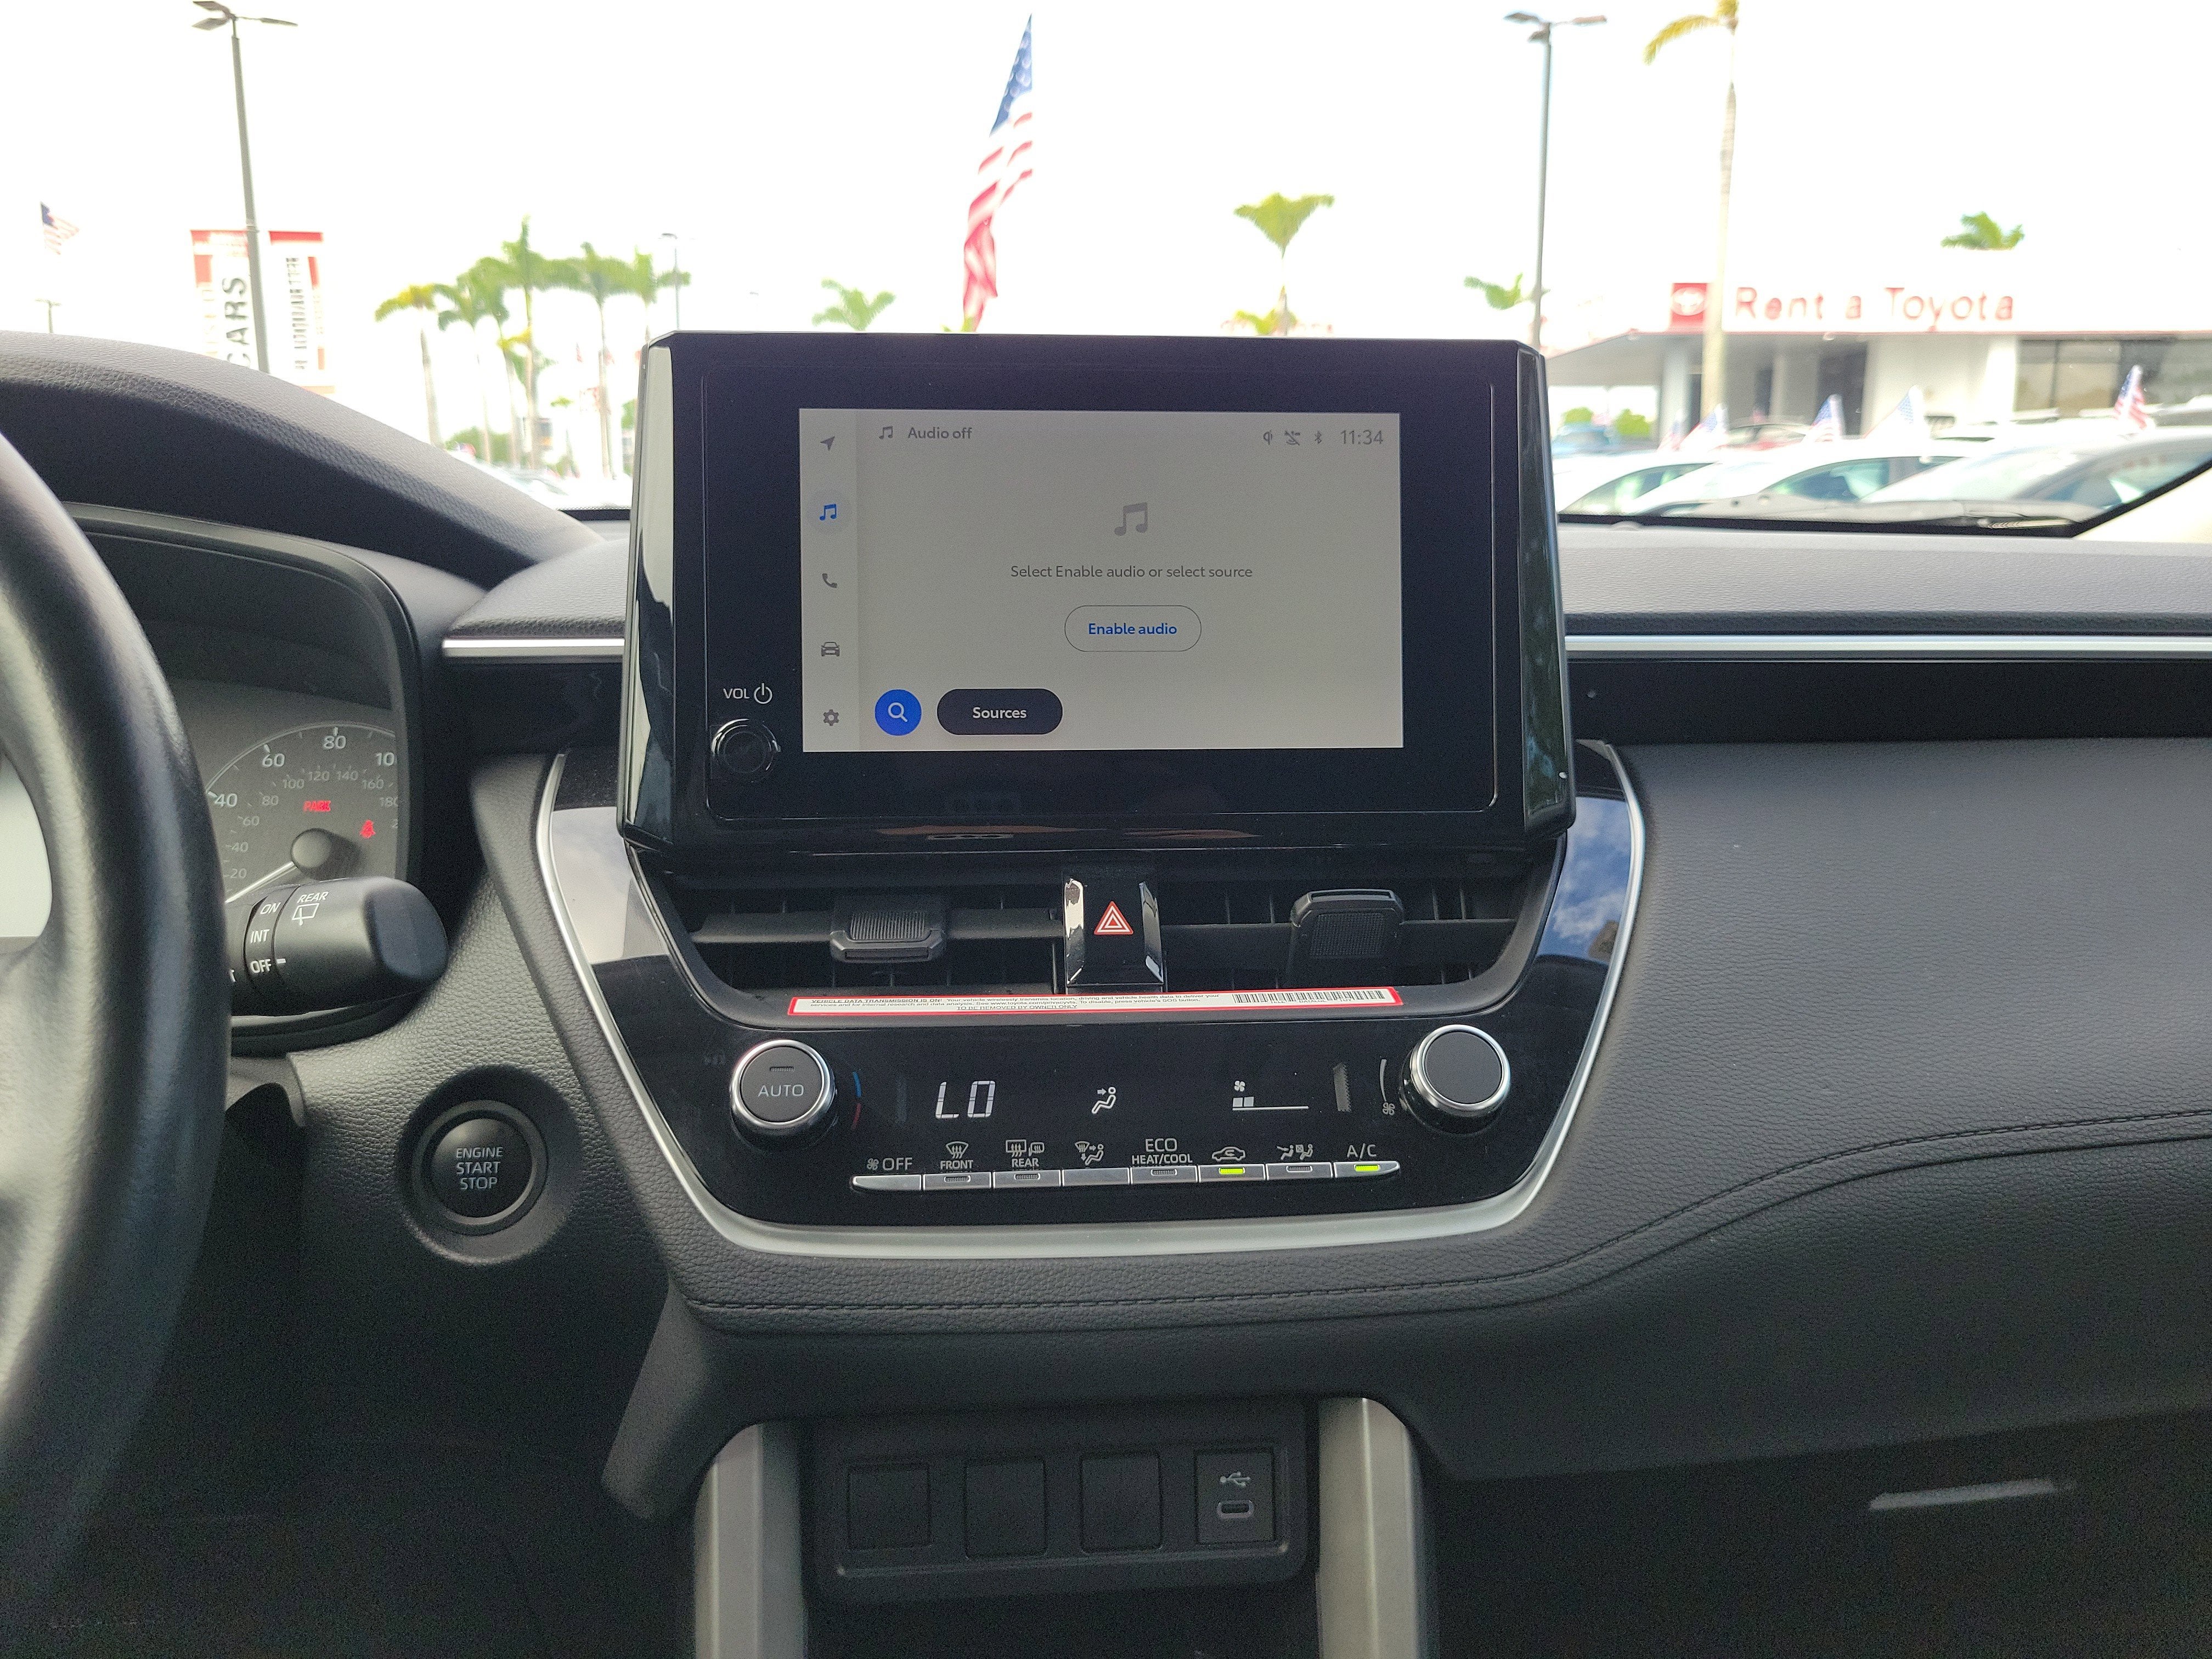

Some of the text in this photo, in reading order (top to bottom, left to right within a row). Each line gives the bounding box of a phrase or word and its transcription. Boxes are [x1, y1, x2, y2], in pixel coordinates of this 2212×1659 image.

[1735, 286, 2015, 332] Rent a Toyota
[222, 277, 251, 368] CARS
[907, 426, 973, 439] Audio off
[1340, 429, 1384, 445] 11:34
[1011, 565, 1253, 578] Select Enable audio or select source
[1088, 623, 1177, 635] Enable audio
[723, 687, 751, 699] VOL
[972, 707, 1027, 719] Sources
[323, 735, 347, 750] 80
[262, 753, 285, 768] 60
[308, 770, 330, 782] 120
[336, 770, 359, 781] 140
[282, 777, 305, 789] 100
[362, 778, 385, 789] 160
[215, 793, 238, 808] 40
[262, 794, 279, 806] 80
[242, 815, 260, 827] 60
[231, 842, 249, 853] 40
[230, 868, 247, 879] 20
[297, 890, 329, 904] REAR
[259, 901, 281, 915] ON
[250, 929, 270, 944] INT
[249, 957, 272, 974] OFF
[758, 1084, 805, 1098] AUTO
[935, 1080, 996, 1120] LO
[1145, 1138, 1178, 1153] ECO
[1346, 1143, 1377, 1159] A/C
[455, 1147, 504, 1159] ENGINE
[1131, 1153, 1193, 1165] HEAT/COOL
[456, 1161, 501, 1175] START
[882, 1157, 913, 1171] OFF
[940, 1159, 974, 1170] FRONT
[1011, 1158, 1040, 1167] REAR
[460, 1176, 498, 1190] STOP
